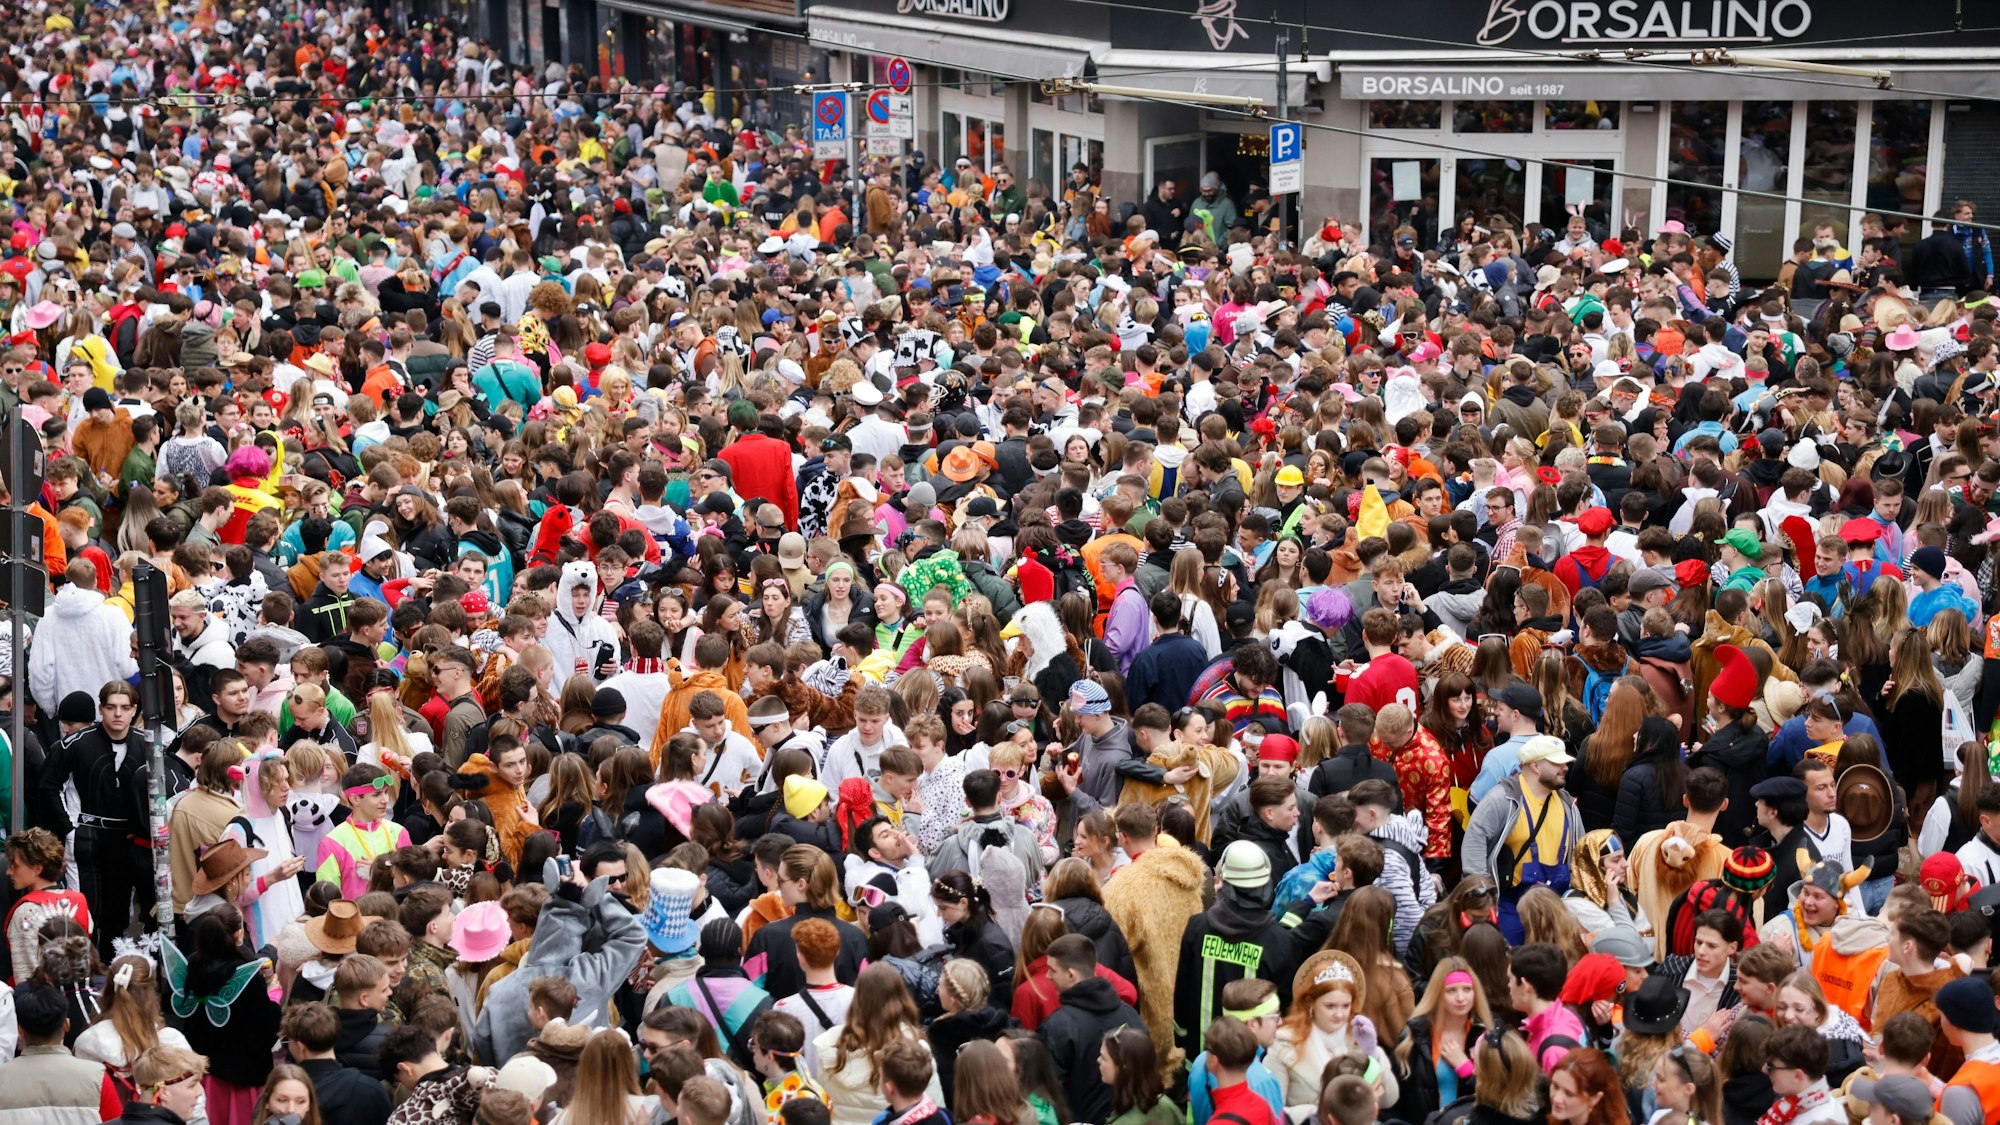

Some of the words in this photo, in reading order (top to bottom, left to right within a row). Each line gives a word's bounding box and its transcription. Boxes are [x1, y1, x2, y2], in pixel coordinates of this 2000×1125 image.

[1476, 0, 1812, 45] BORSALINO
[1362, 76, 1504, 96] BORSALINO
[1510, 85, 1533, 96] seit
[1535, 84, 1565, 96] 1987
[1277, 128, 1295, 159] P
[1203, 937, 1260, 967] FEUERWEHR
